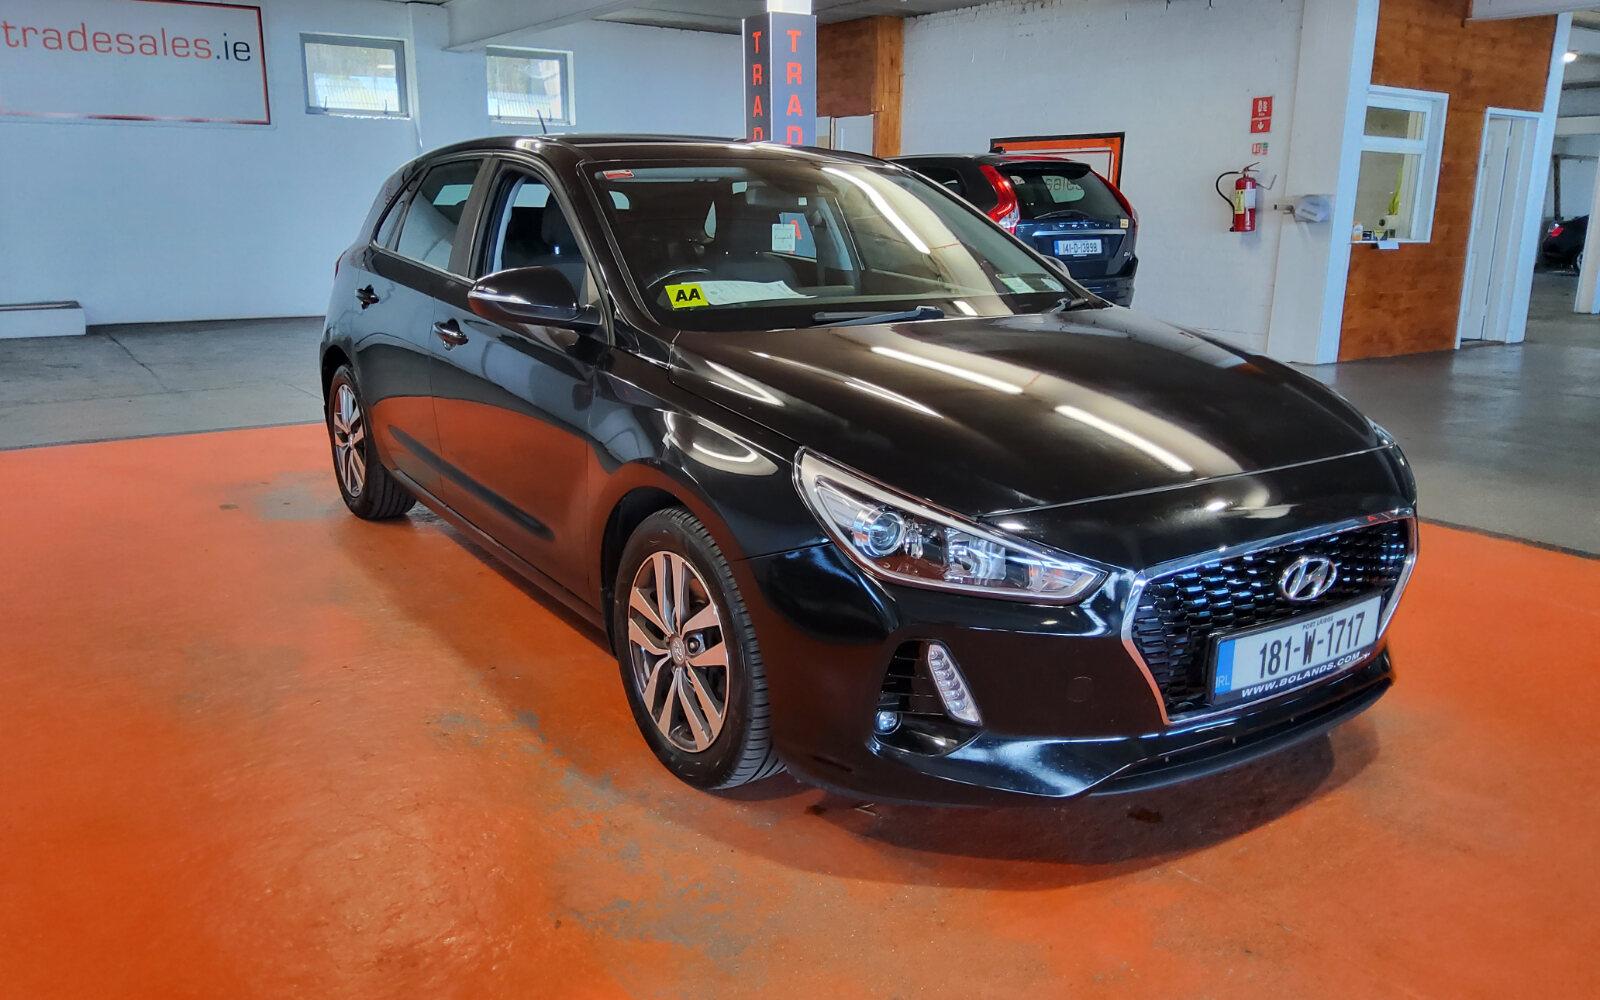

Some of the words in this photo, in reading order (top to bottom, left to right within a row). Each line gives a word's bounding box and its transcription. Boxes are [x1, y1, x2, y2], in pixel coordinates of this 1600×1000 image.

[1, 20, 251, 62] tradesales.ie
[675, 288, 701, 302] AA
[1259, 612, 1365, 679] 181-W-1717
[1241, 651, 1361, 699] WWW.BOLANDS.COM
